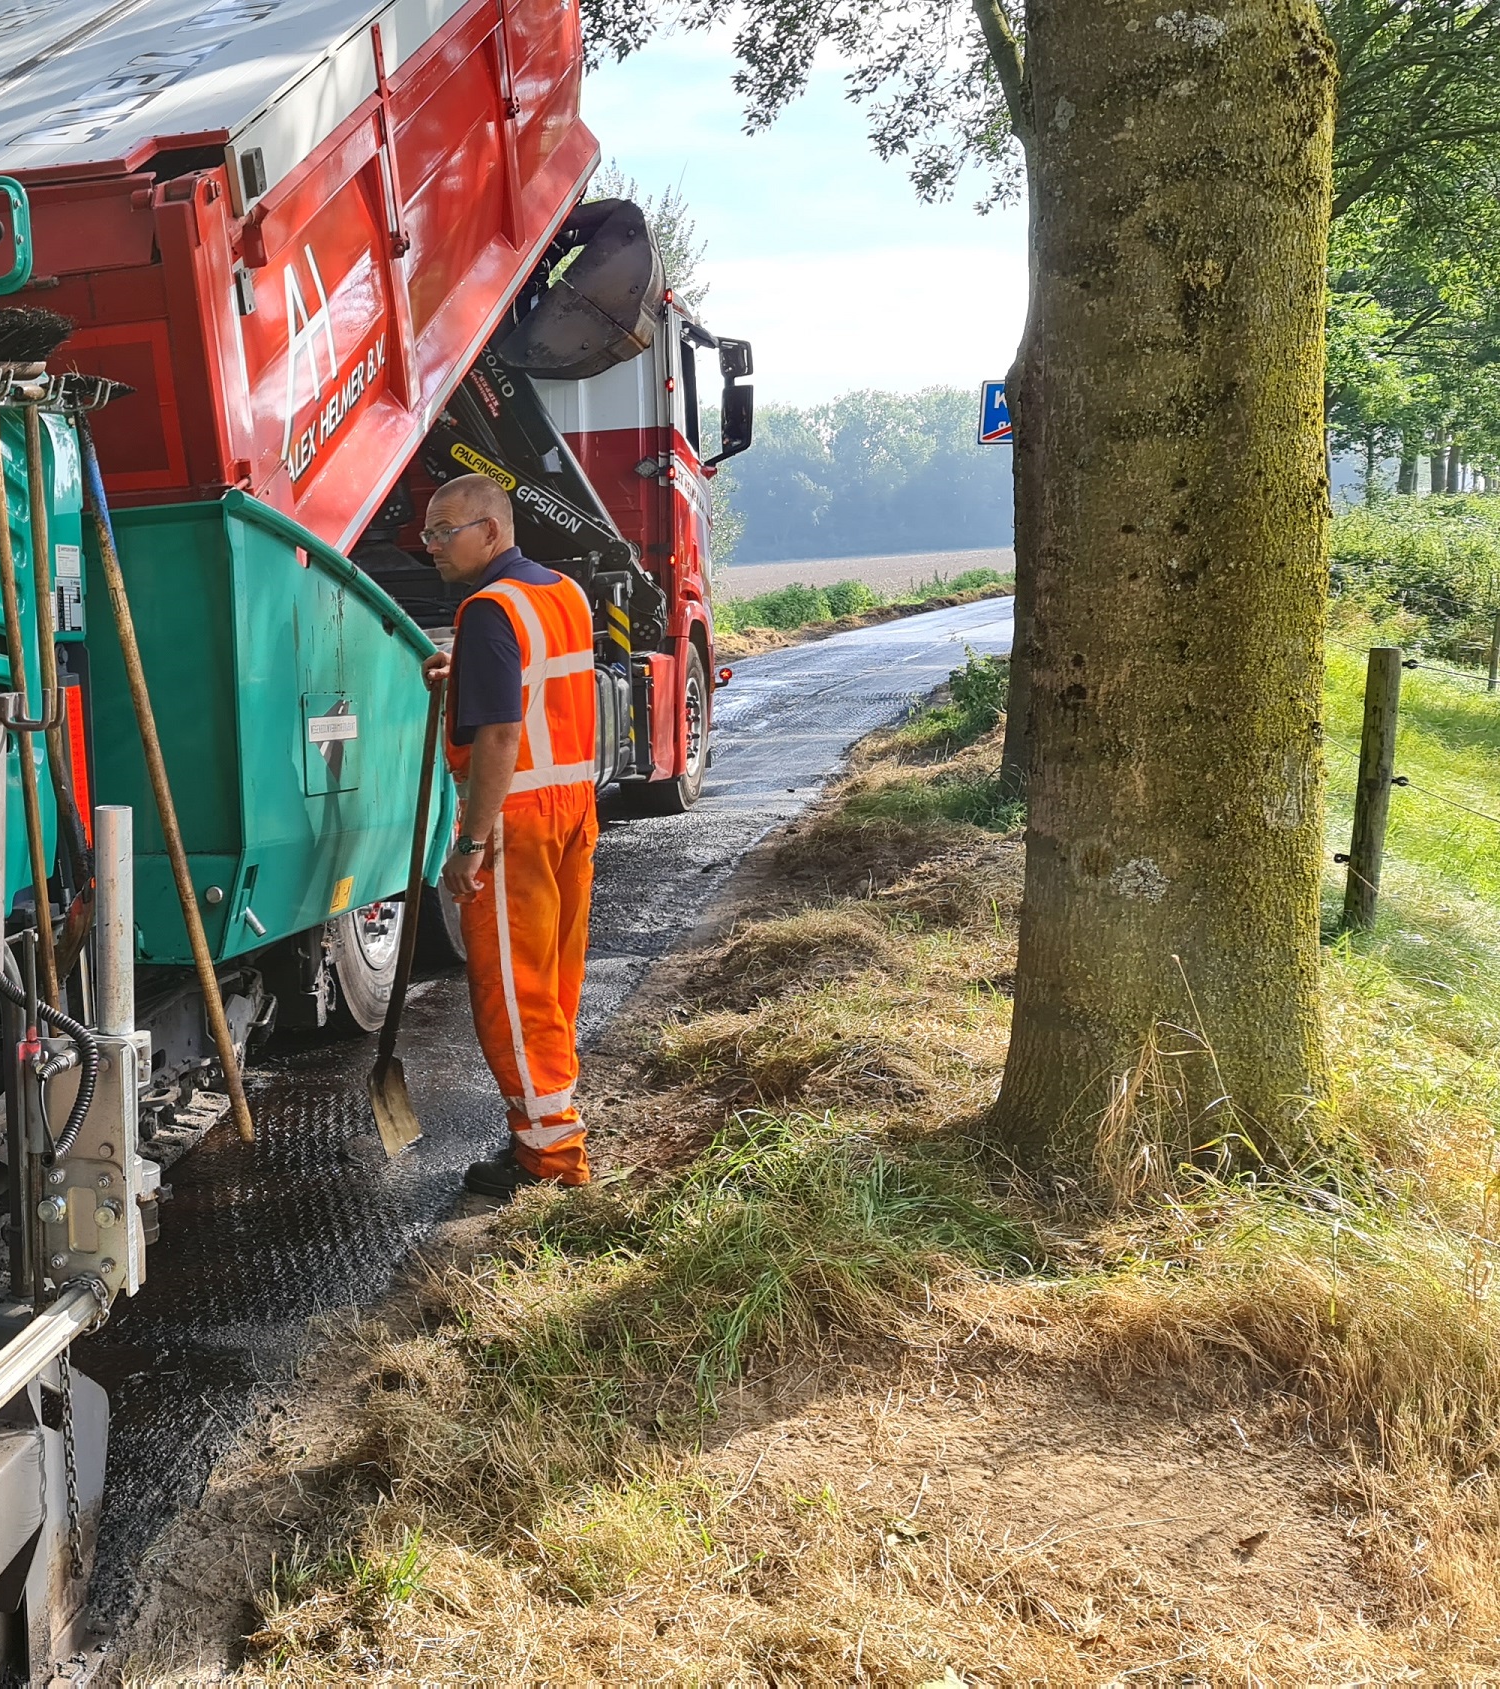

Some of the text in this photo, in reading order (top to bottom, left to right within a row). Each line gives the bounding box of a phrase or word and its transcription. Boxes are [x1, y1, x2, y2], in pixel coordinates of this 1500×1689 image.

[287, 332, 386, 483] ALEX HELMER B.V.
[453, 446, 513, 488] PALFINGER
[516, 484, 582, 534] EPSILON
